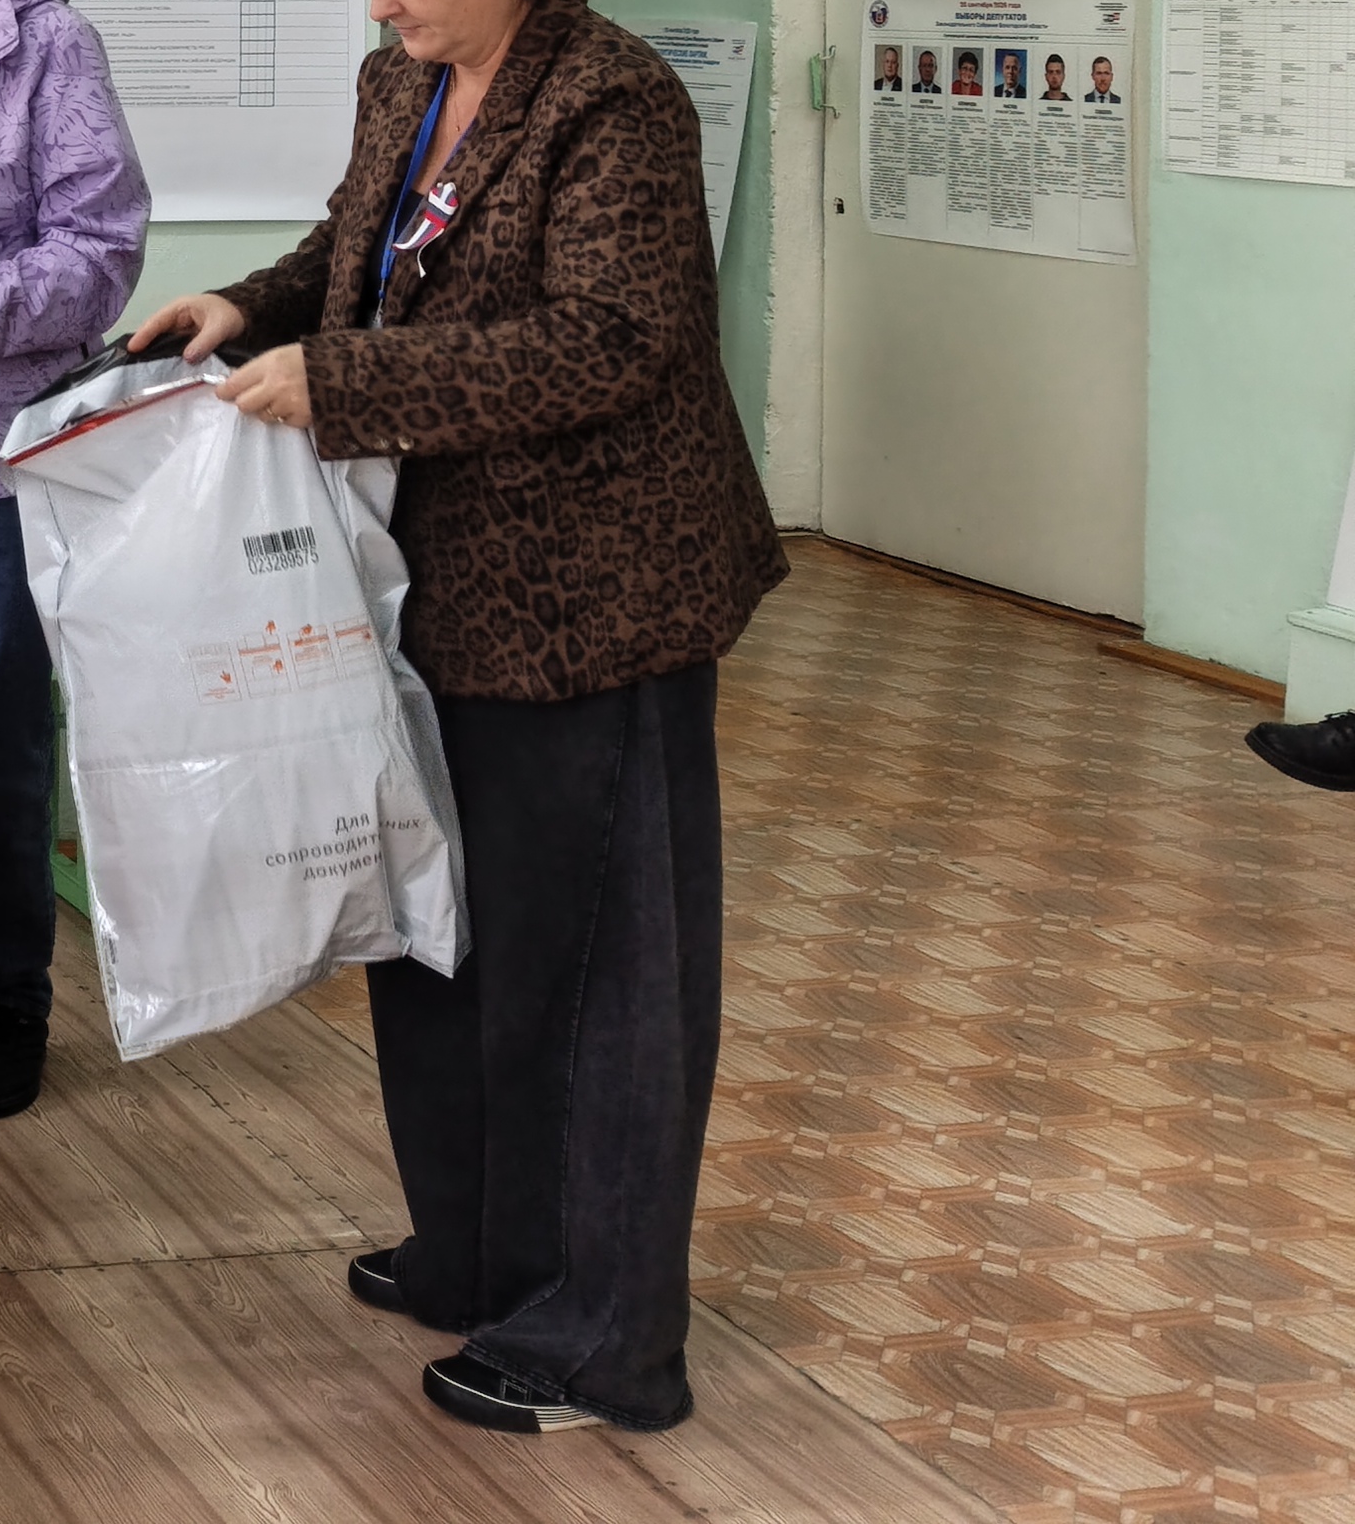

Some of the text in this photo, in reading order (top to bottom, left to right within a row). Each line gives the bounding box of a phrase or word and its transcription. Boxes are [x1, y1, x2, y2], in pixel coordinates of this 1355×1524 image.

[955, 12, 1027, 21] ВЫБОРЫ ДЕПУТАТОВ
[335, 813, 370, 836] Для
